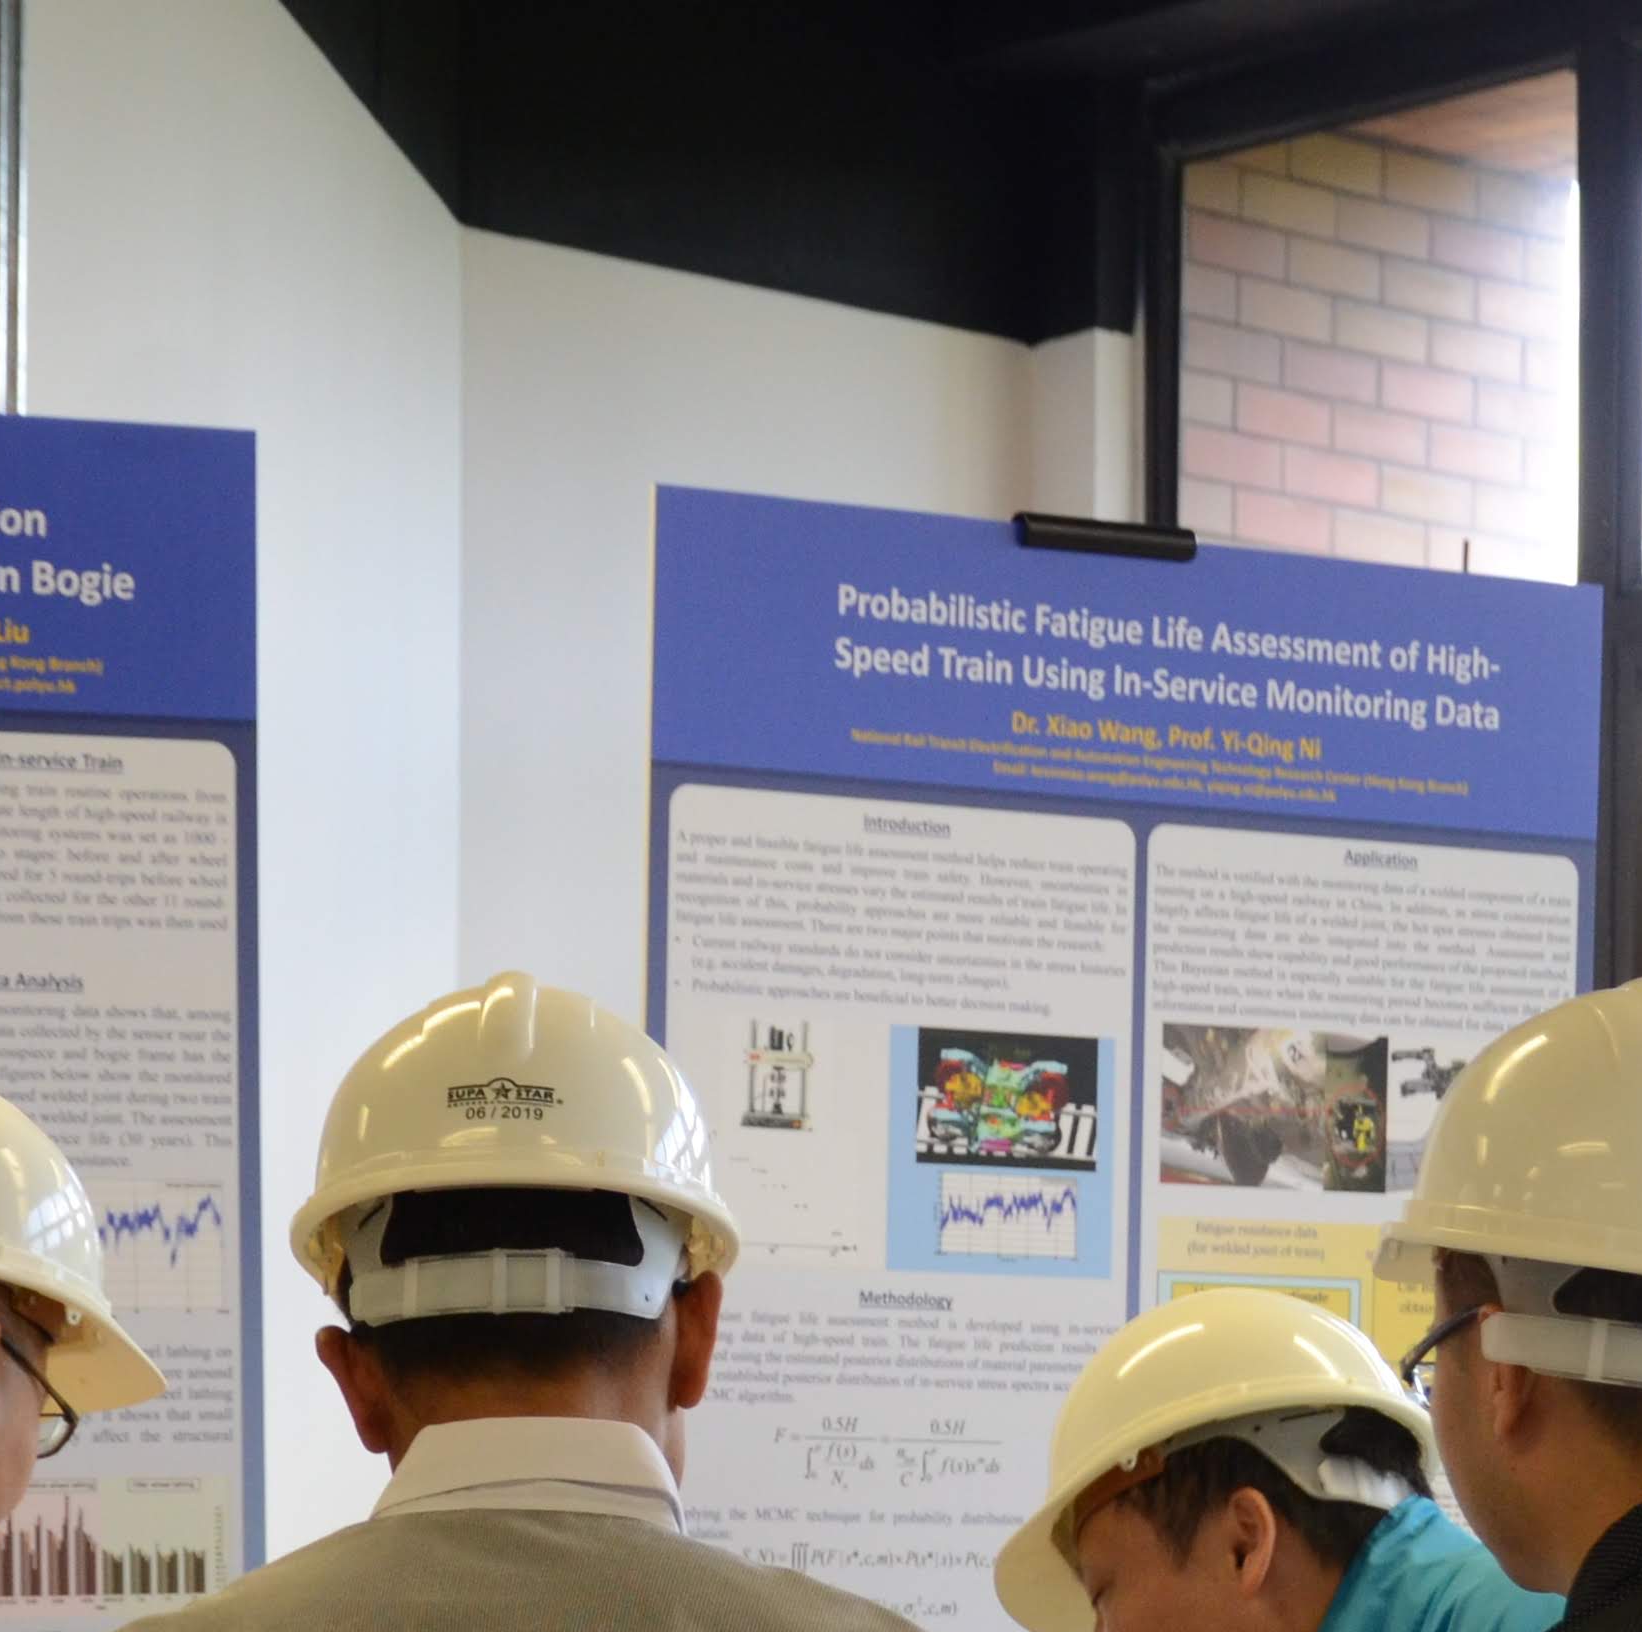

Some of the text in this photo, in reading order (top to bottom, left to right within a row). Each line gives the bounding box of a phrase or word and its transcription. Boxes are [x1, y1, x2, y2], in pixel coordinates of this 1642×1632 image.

[30, 556, 137, 602] Bogie
[838, 585, 1500, 684] Probabilistic Fatigue Life Assessment of High-
[835, 638, 1500, 729] Speed Train Using In-Service Monitoring Data
[1011, 710, 1322, 761] Dr. Xiao Wang, Prof. Yi-Qing Ni
[83, 753, 122, 769] Train
[863, 815, 950, 833] Introduction
[1344, 849, 1417, 866] Application
[15, 973, 83, 992] Analysis
[859, 1290, 952, 1310] Methodology
